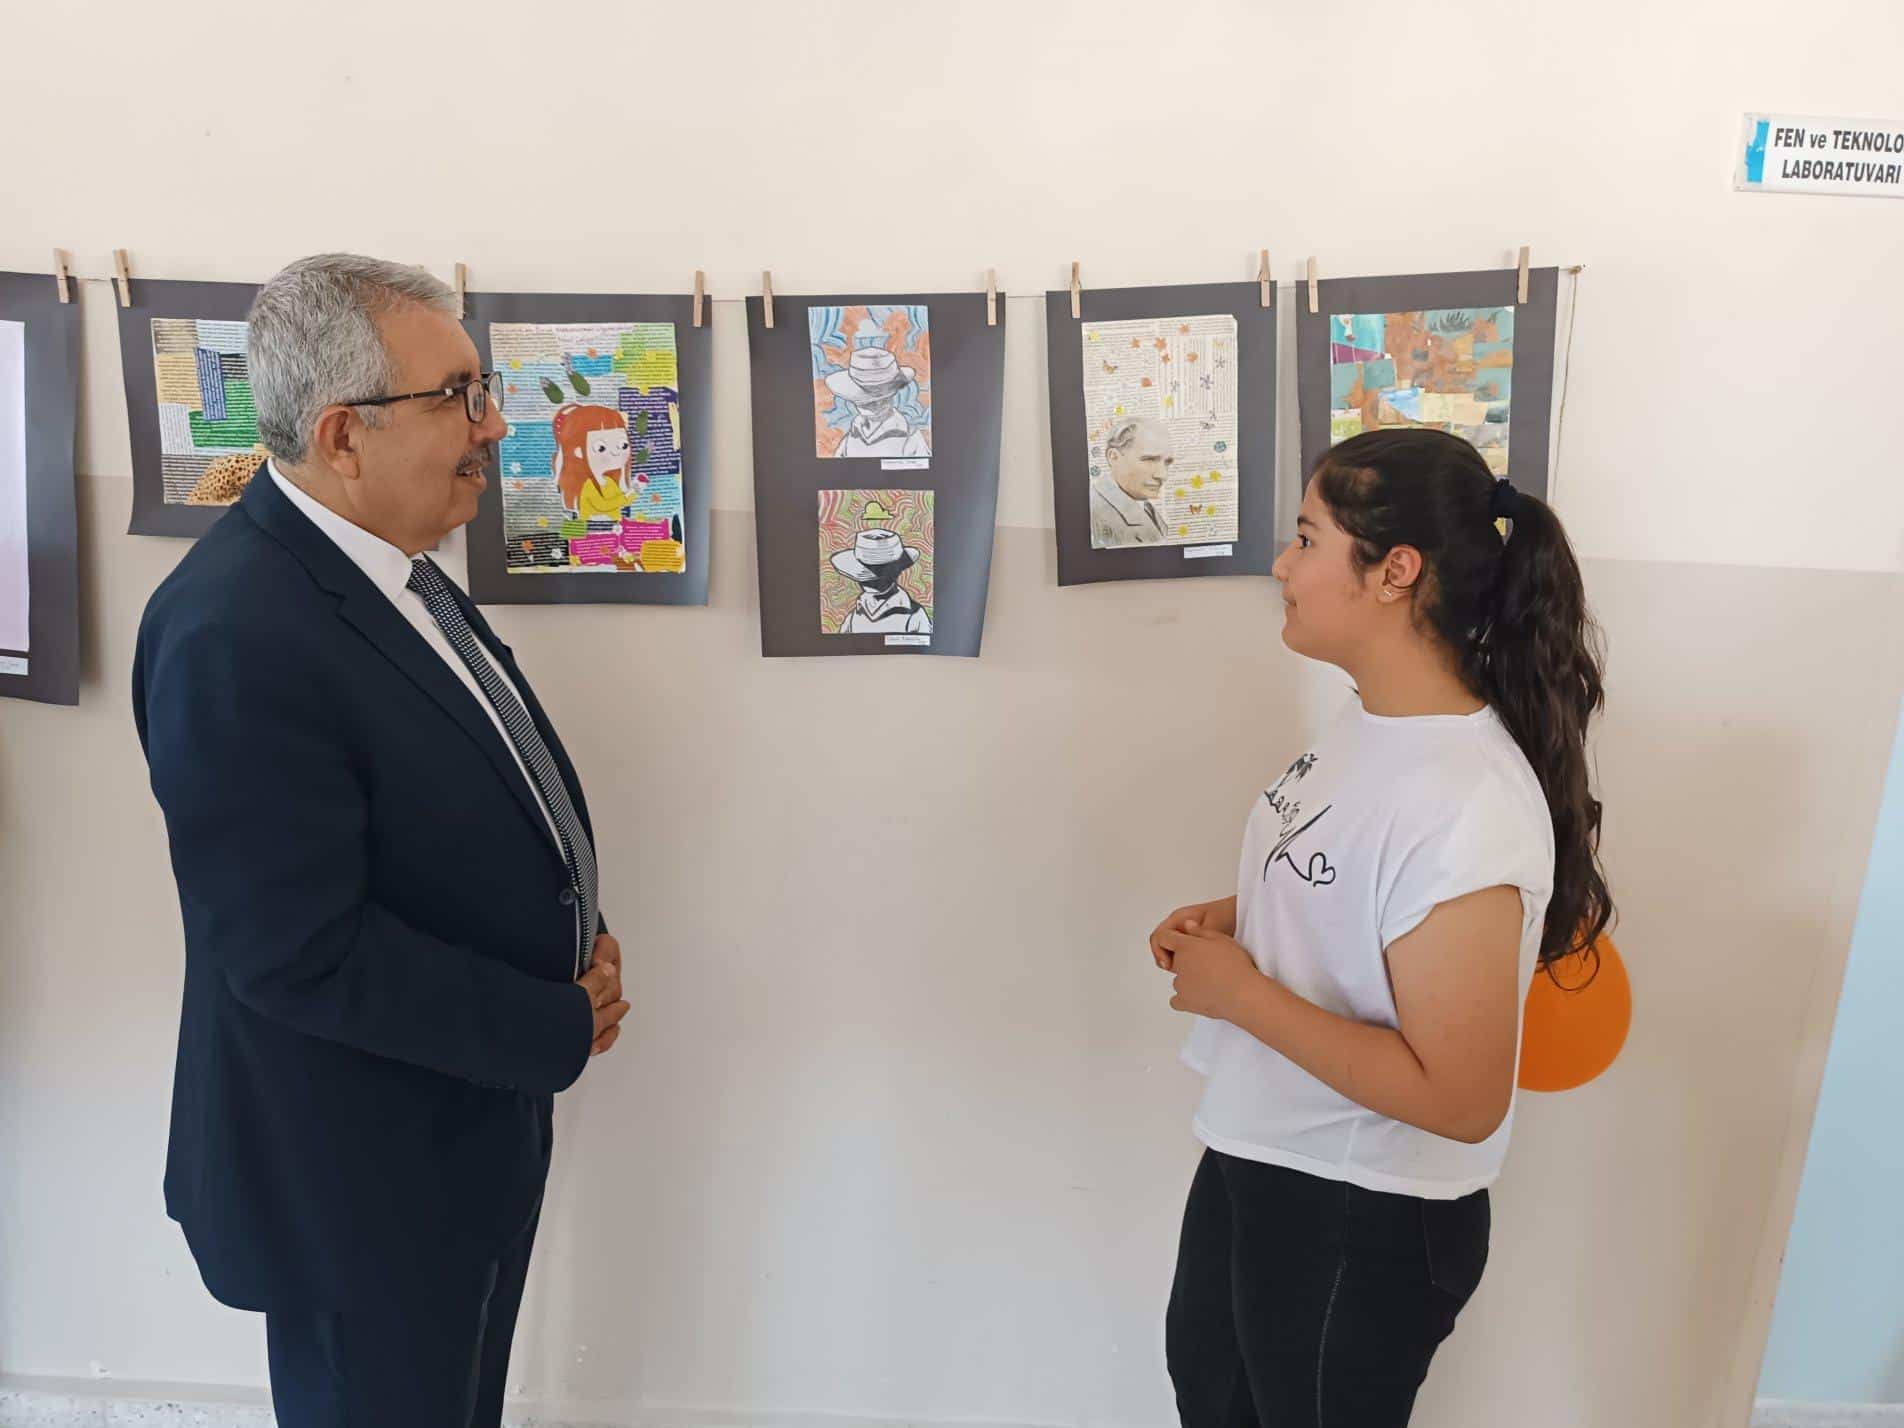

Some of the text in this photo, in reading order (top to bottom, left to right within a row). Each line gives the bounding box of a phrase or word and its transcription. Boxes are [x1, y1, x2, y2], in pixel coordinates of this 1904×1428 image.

[1774, 128, 1904, 154] FEN ve TEKNOLO
[1781, 159, 1902, 184] LABORATUVARI
